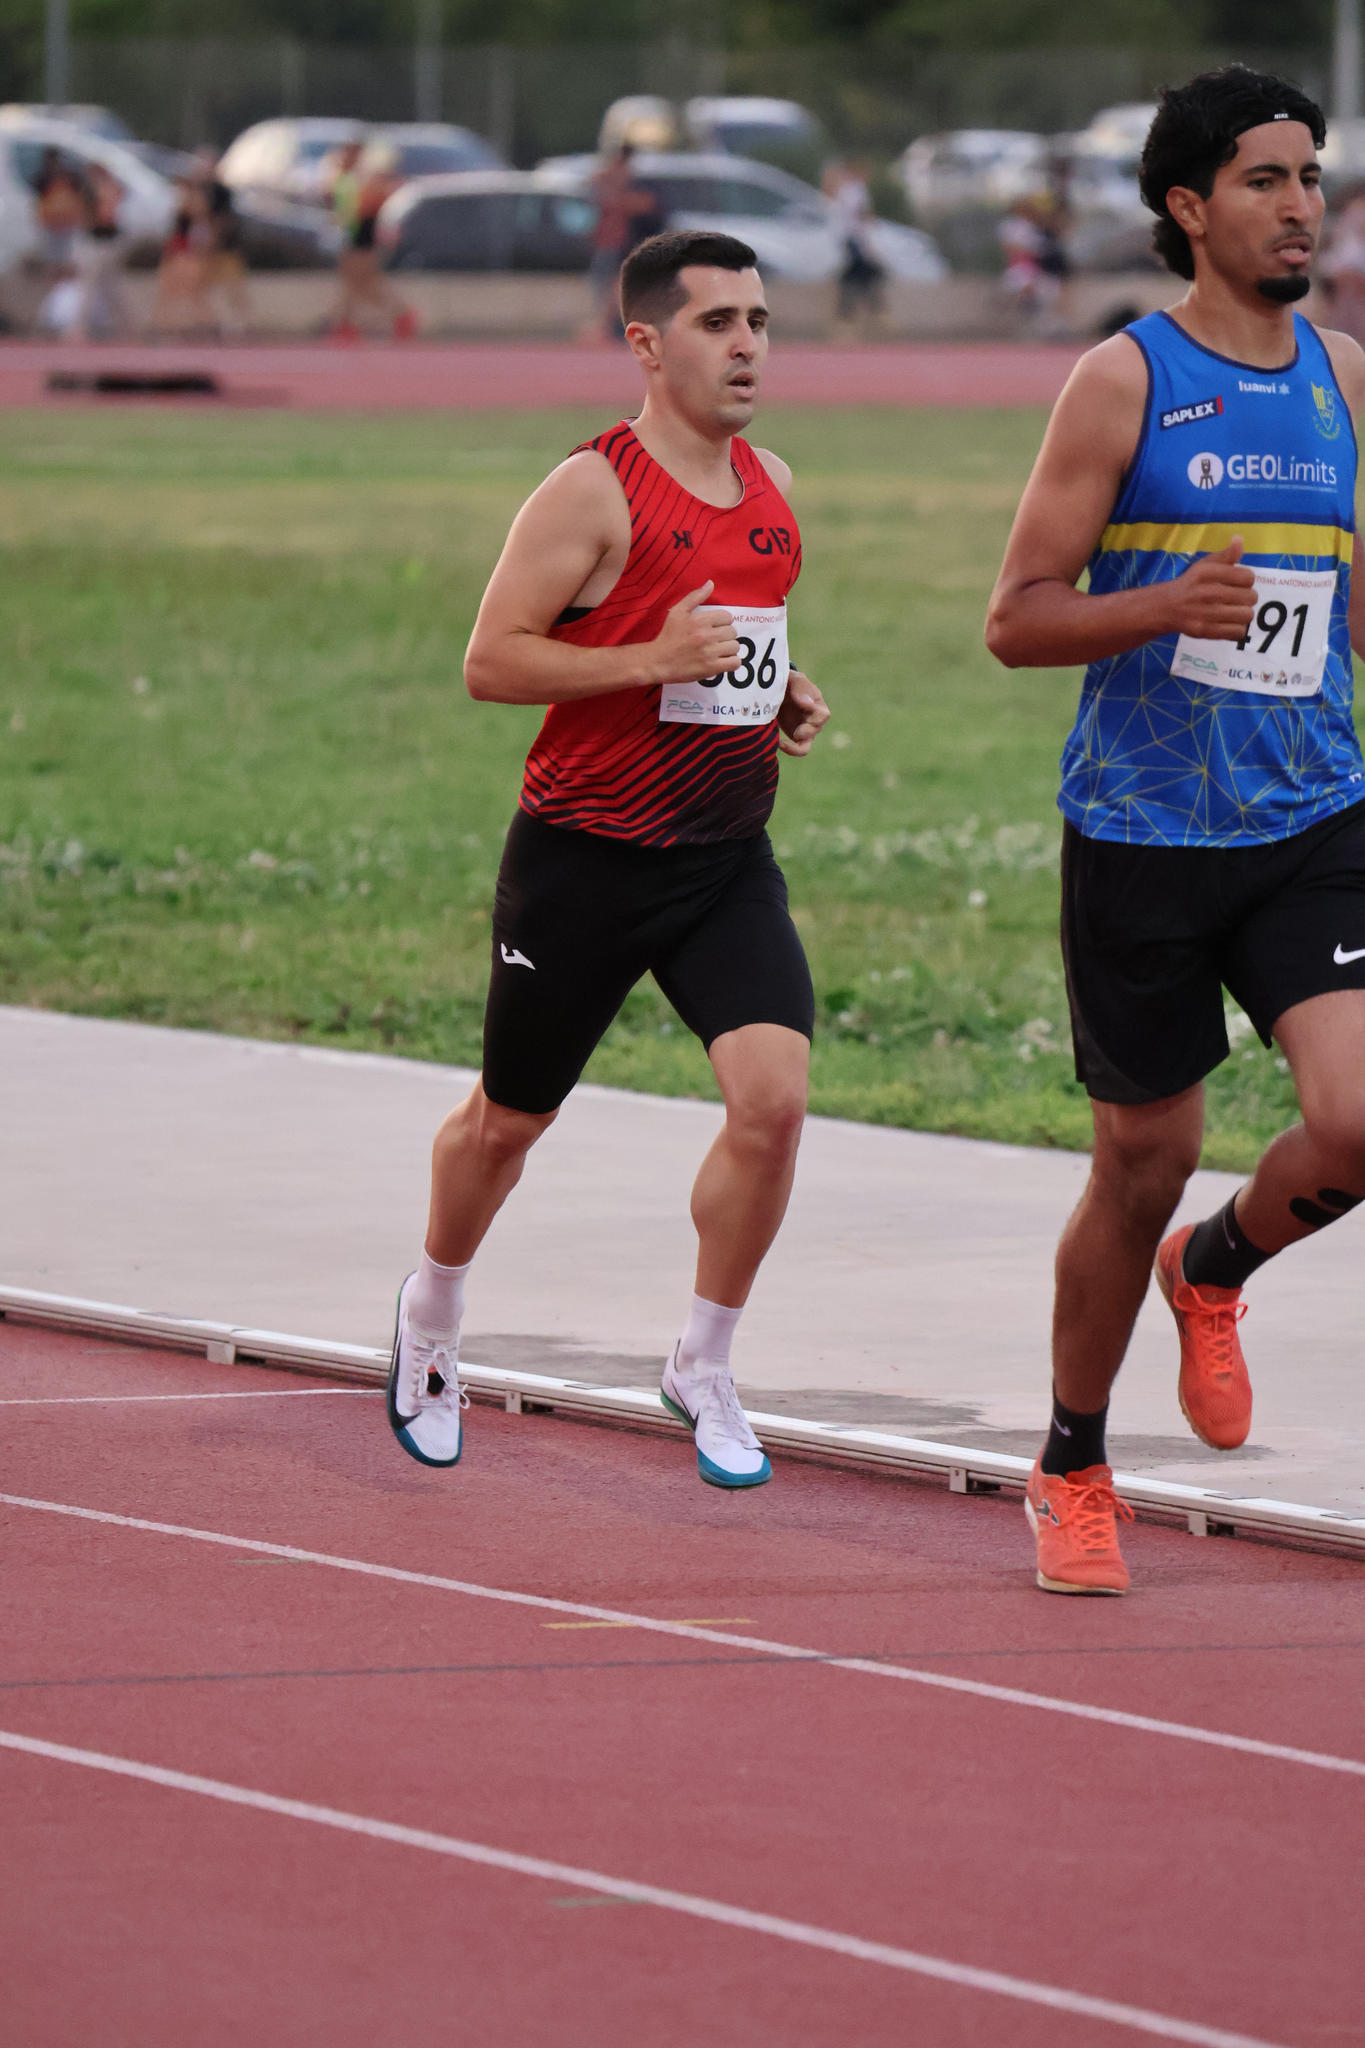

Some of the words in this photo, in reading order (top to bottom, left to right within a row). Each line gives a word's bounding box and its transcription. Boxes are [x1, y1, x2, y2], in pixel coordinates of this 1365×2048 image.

[1238, 380, 1276, 394] luanvi
[1163, 402, 1215, 427] SAPLEX
[1228, 668, 1253, 680] UCA
[712, 705, 735, 715] UCA
